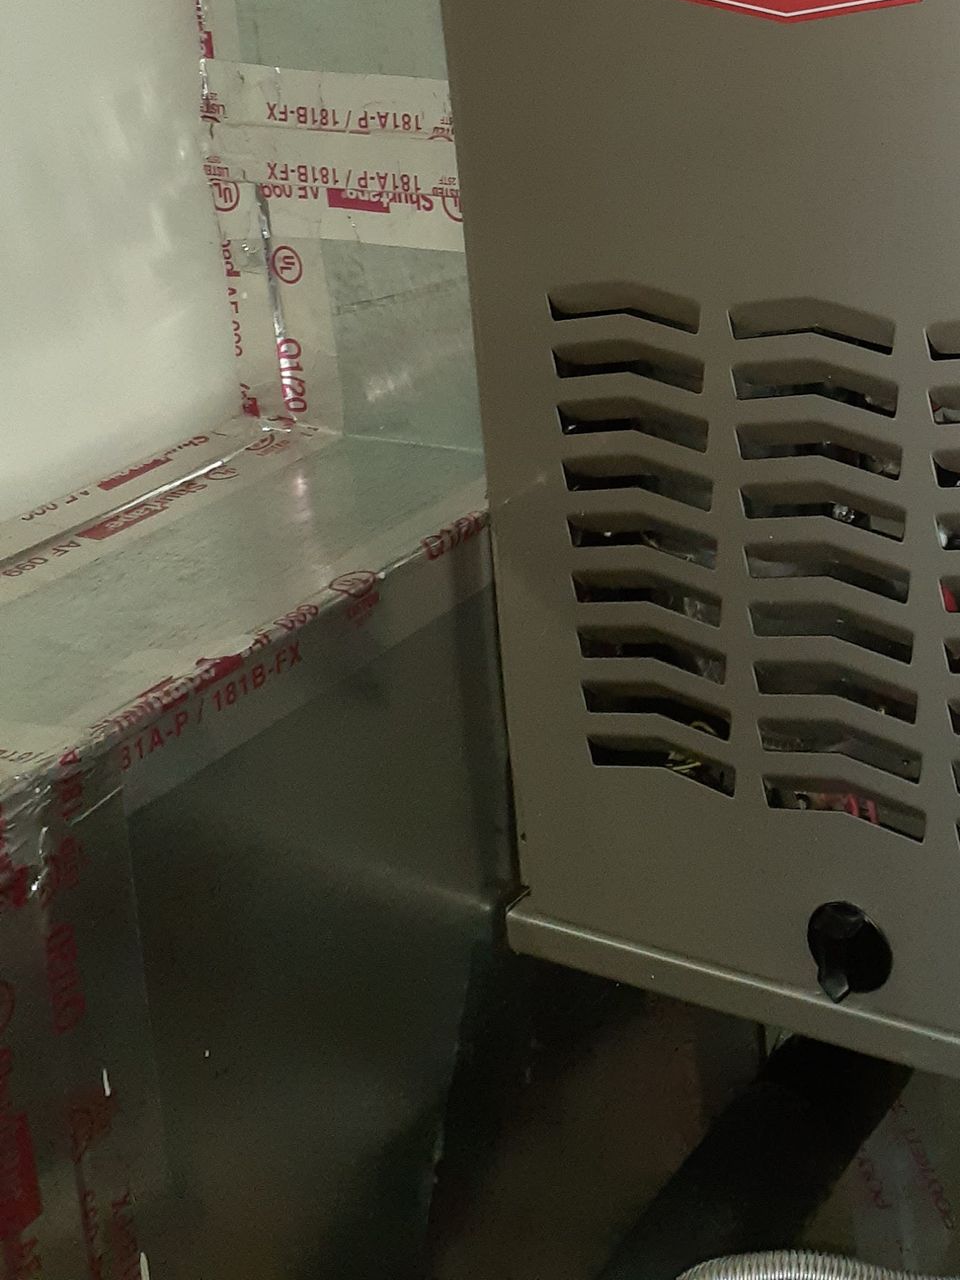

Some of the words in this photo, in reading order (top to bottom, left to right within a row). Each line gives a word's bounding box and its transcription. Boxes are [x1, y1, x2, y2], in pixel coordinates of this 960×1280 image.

[266, 101, 339, 127] 181B-FX
[357, 111, 423, 131] 181A-P
[266, 161, 340, 186] 181B-FX
[357, 173, 422, 193] 181A-P
[213, 640, 303, 712] 181B-FX
